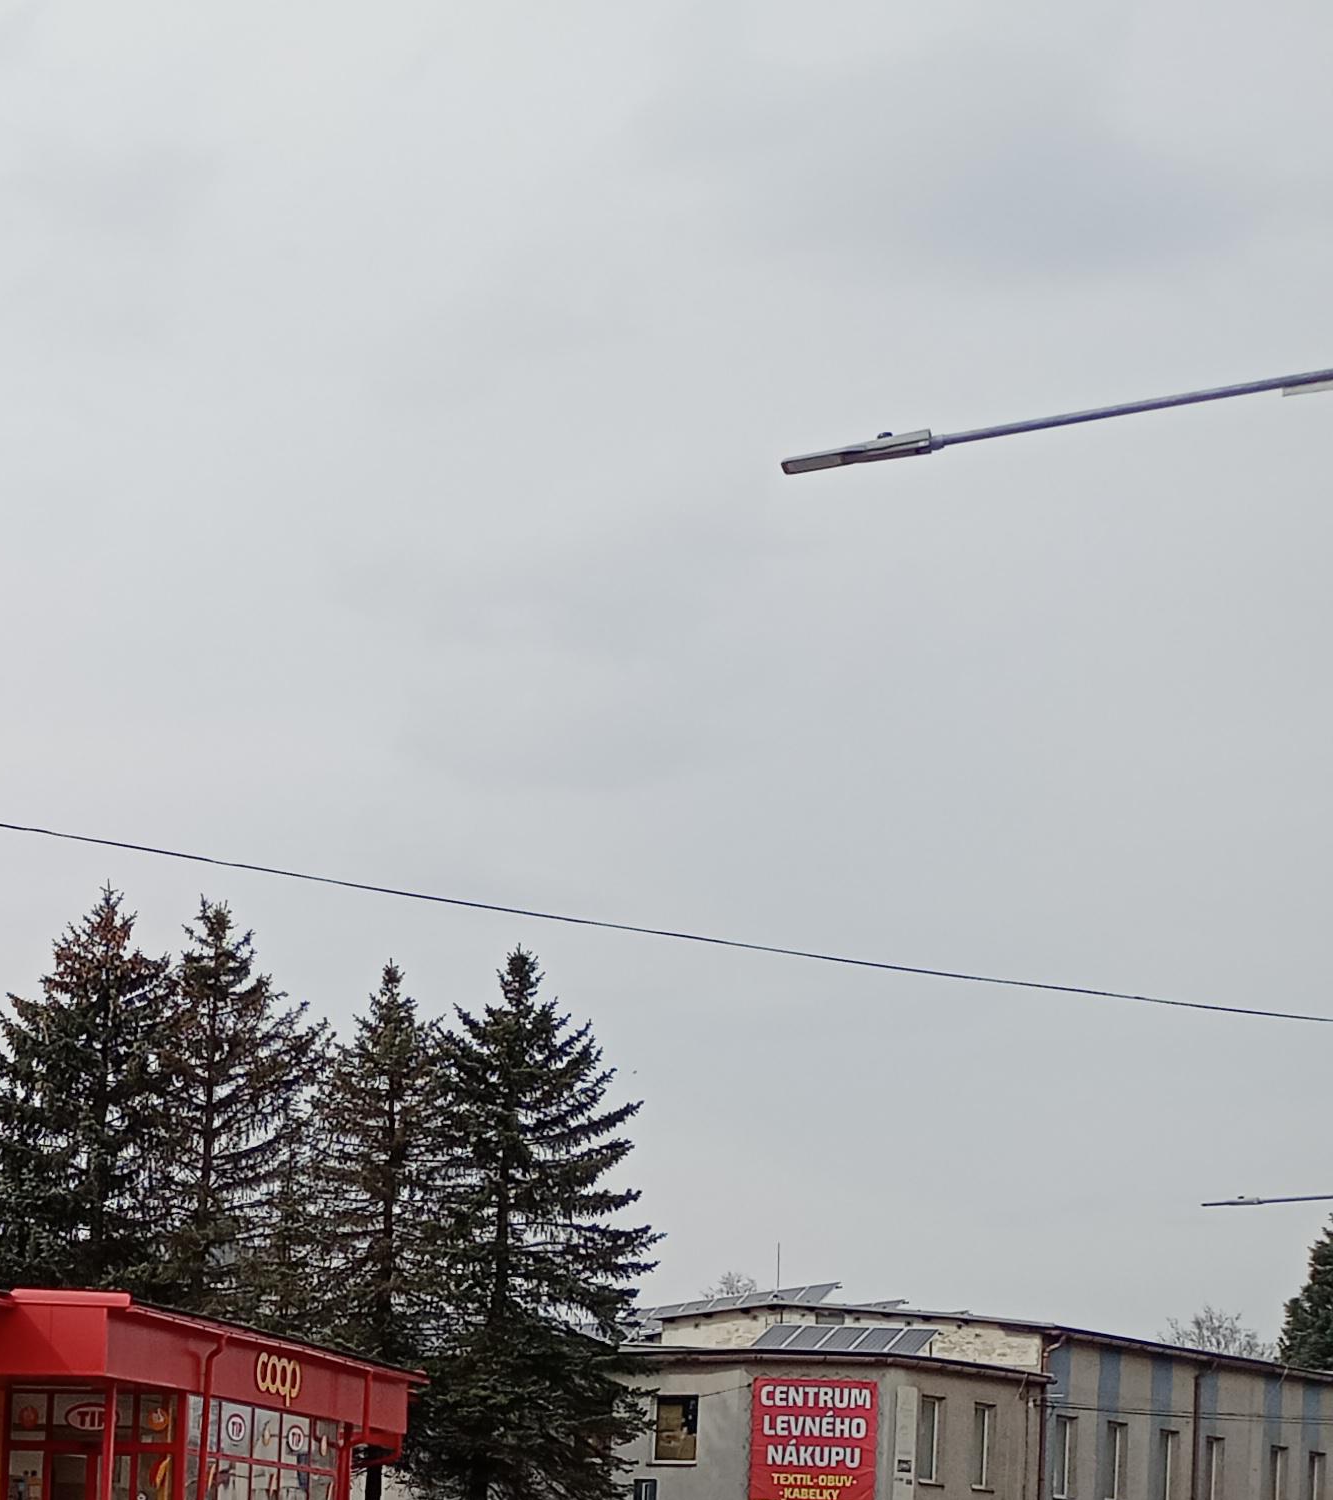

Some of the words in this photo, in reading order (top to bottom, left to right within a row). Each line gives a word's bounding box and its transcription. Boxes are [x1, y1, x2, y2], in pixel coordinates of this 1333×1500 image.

[760, 1385, 871, 1409] CENTRUM
[763, 1411, 867, 1438] LEVNÉHO
[766, 1439, 861, 1468] NÁKUPU
